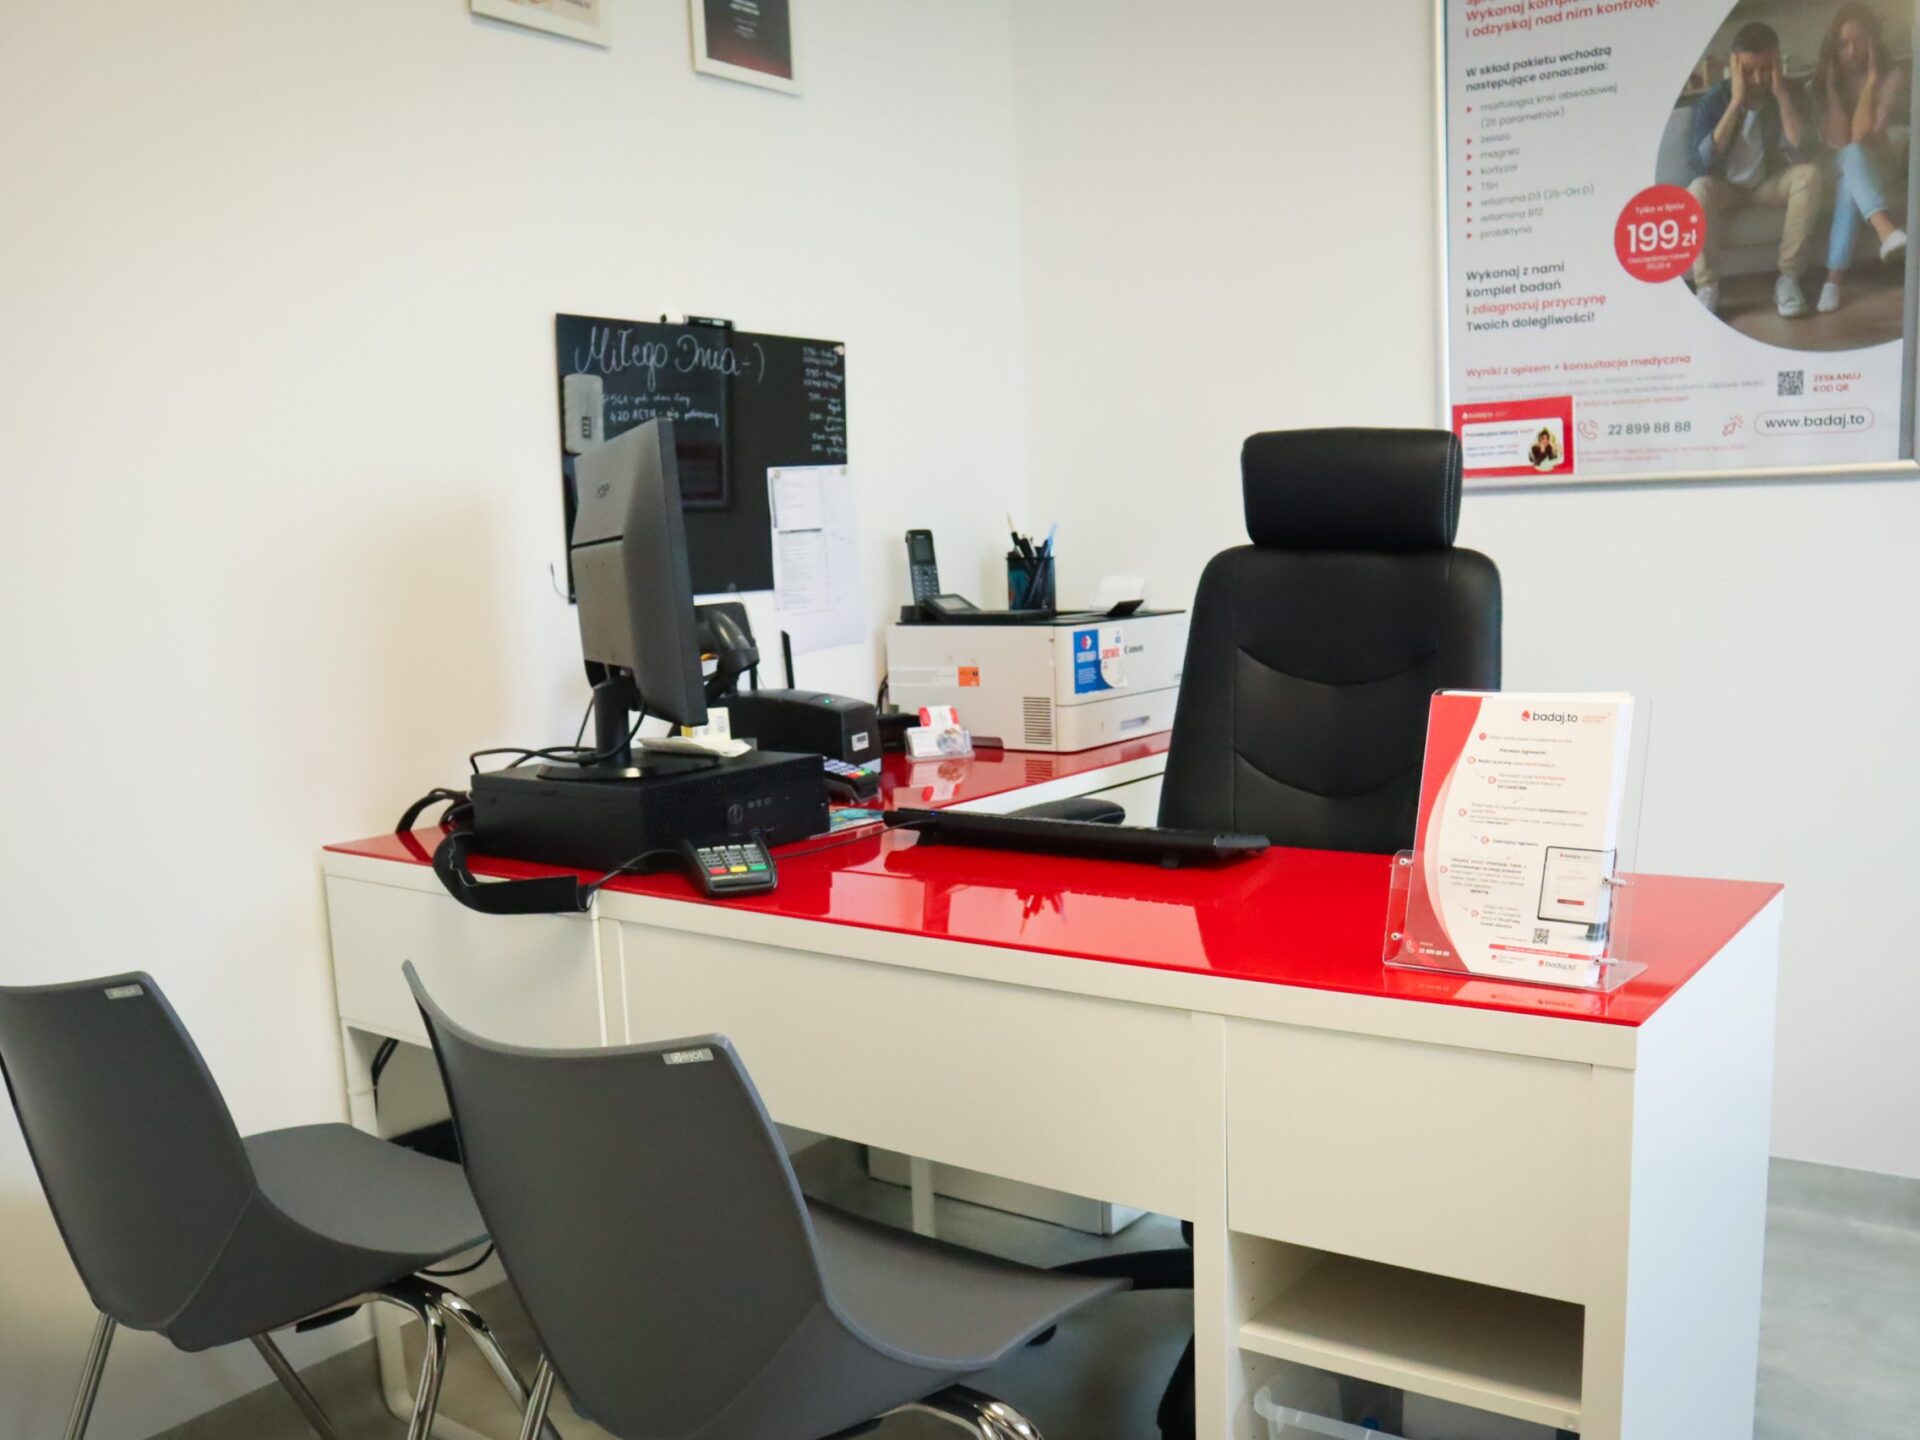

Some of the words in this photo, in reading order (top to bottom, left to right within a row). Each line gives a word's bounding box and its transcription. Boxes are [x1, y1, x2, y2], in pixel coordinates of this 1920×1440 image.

[1465, 27, 1470, 38] i
[1472, 16, 1532, 36] odzyskaj
[1535, 10, 1562, 26] nad
[1566, 7, 1593, 20] nim
[1466, 3, 1525, 22] Wykonaj
[1466, 67, 1477, 78] W
[1480, 61, 1510, 76] skład
[1513, 54, 1556, 72] pakietu
[1559, 45, 1612, 63] wchodzą
[1466, 73, 1536, 92] następujące
[1539, 61, 1608, 81] oznaczenia:
[1626, 219, 1679, 254] 199
[1466, 266, 1520, 283] Wykonaj
[1522, 267, 1529, 276] z
[1531, 261, 1565, 276] nami
[1466, 283, 1517, 299] komplet
[1519, 280, 1562, 294] badań
[1465, 304, 1470, 315] i
[1472, 298, 1540, 315] zdiagnozuj
[1541, 294, 1607, 311] przyczynę
[1466, 319, 1510, 332] Twoich
[1511, 311, 1595, 330] dolegliwości!
[1466, 365, 1501, 379] Wyniki
[1511, 361, 1551, 375] opisem
[1562, 356, 1629, 371] konsultacja
[1813, 372, 1862, 382] ZESKANUJ
[1813, 384, 1834, 393] KOD
[1835, 383, 1850, 393] QR
[1608, 424, 1623, 436] 22
[1625, 422, 1651, 435] 899
[1653, 421, 1671, 433] 88
[1674, 420, 1693, 433] 88
[1765, 413, 1866, 430] www.badaj.to
[1532, 711, 1579, 725] badaj.to
